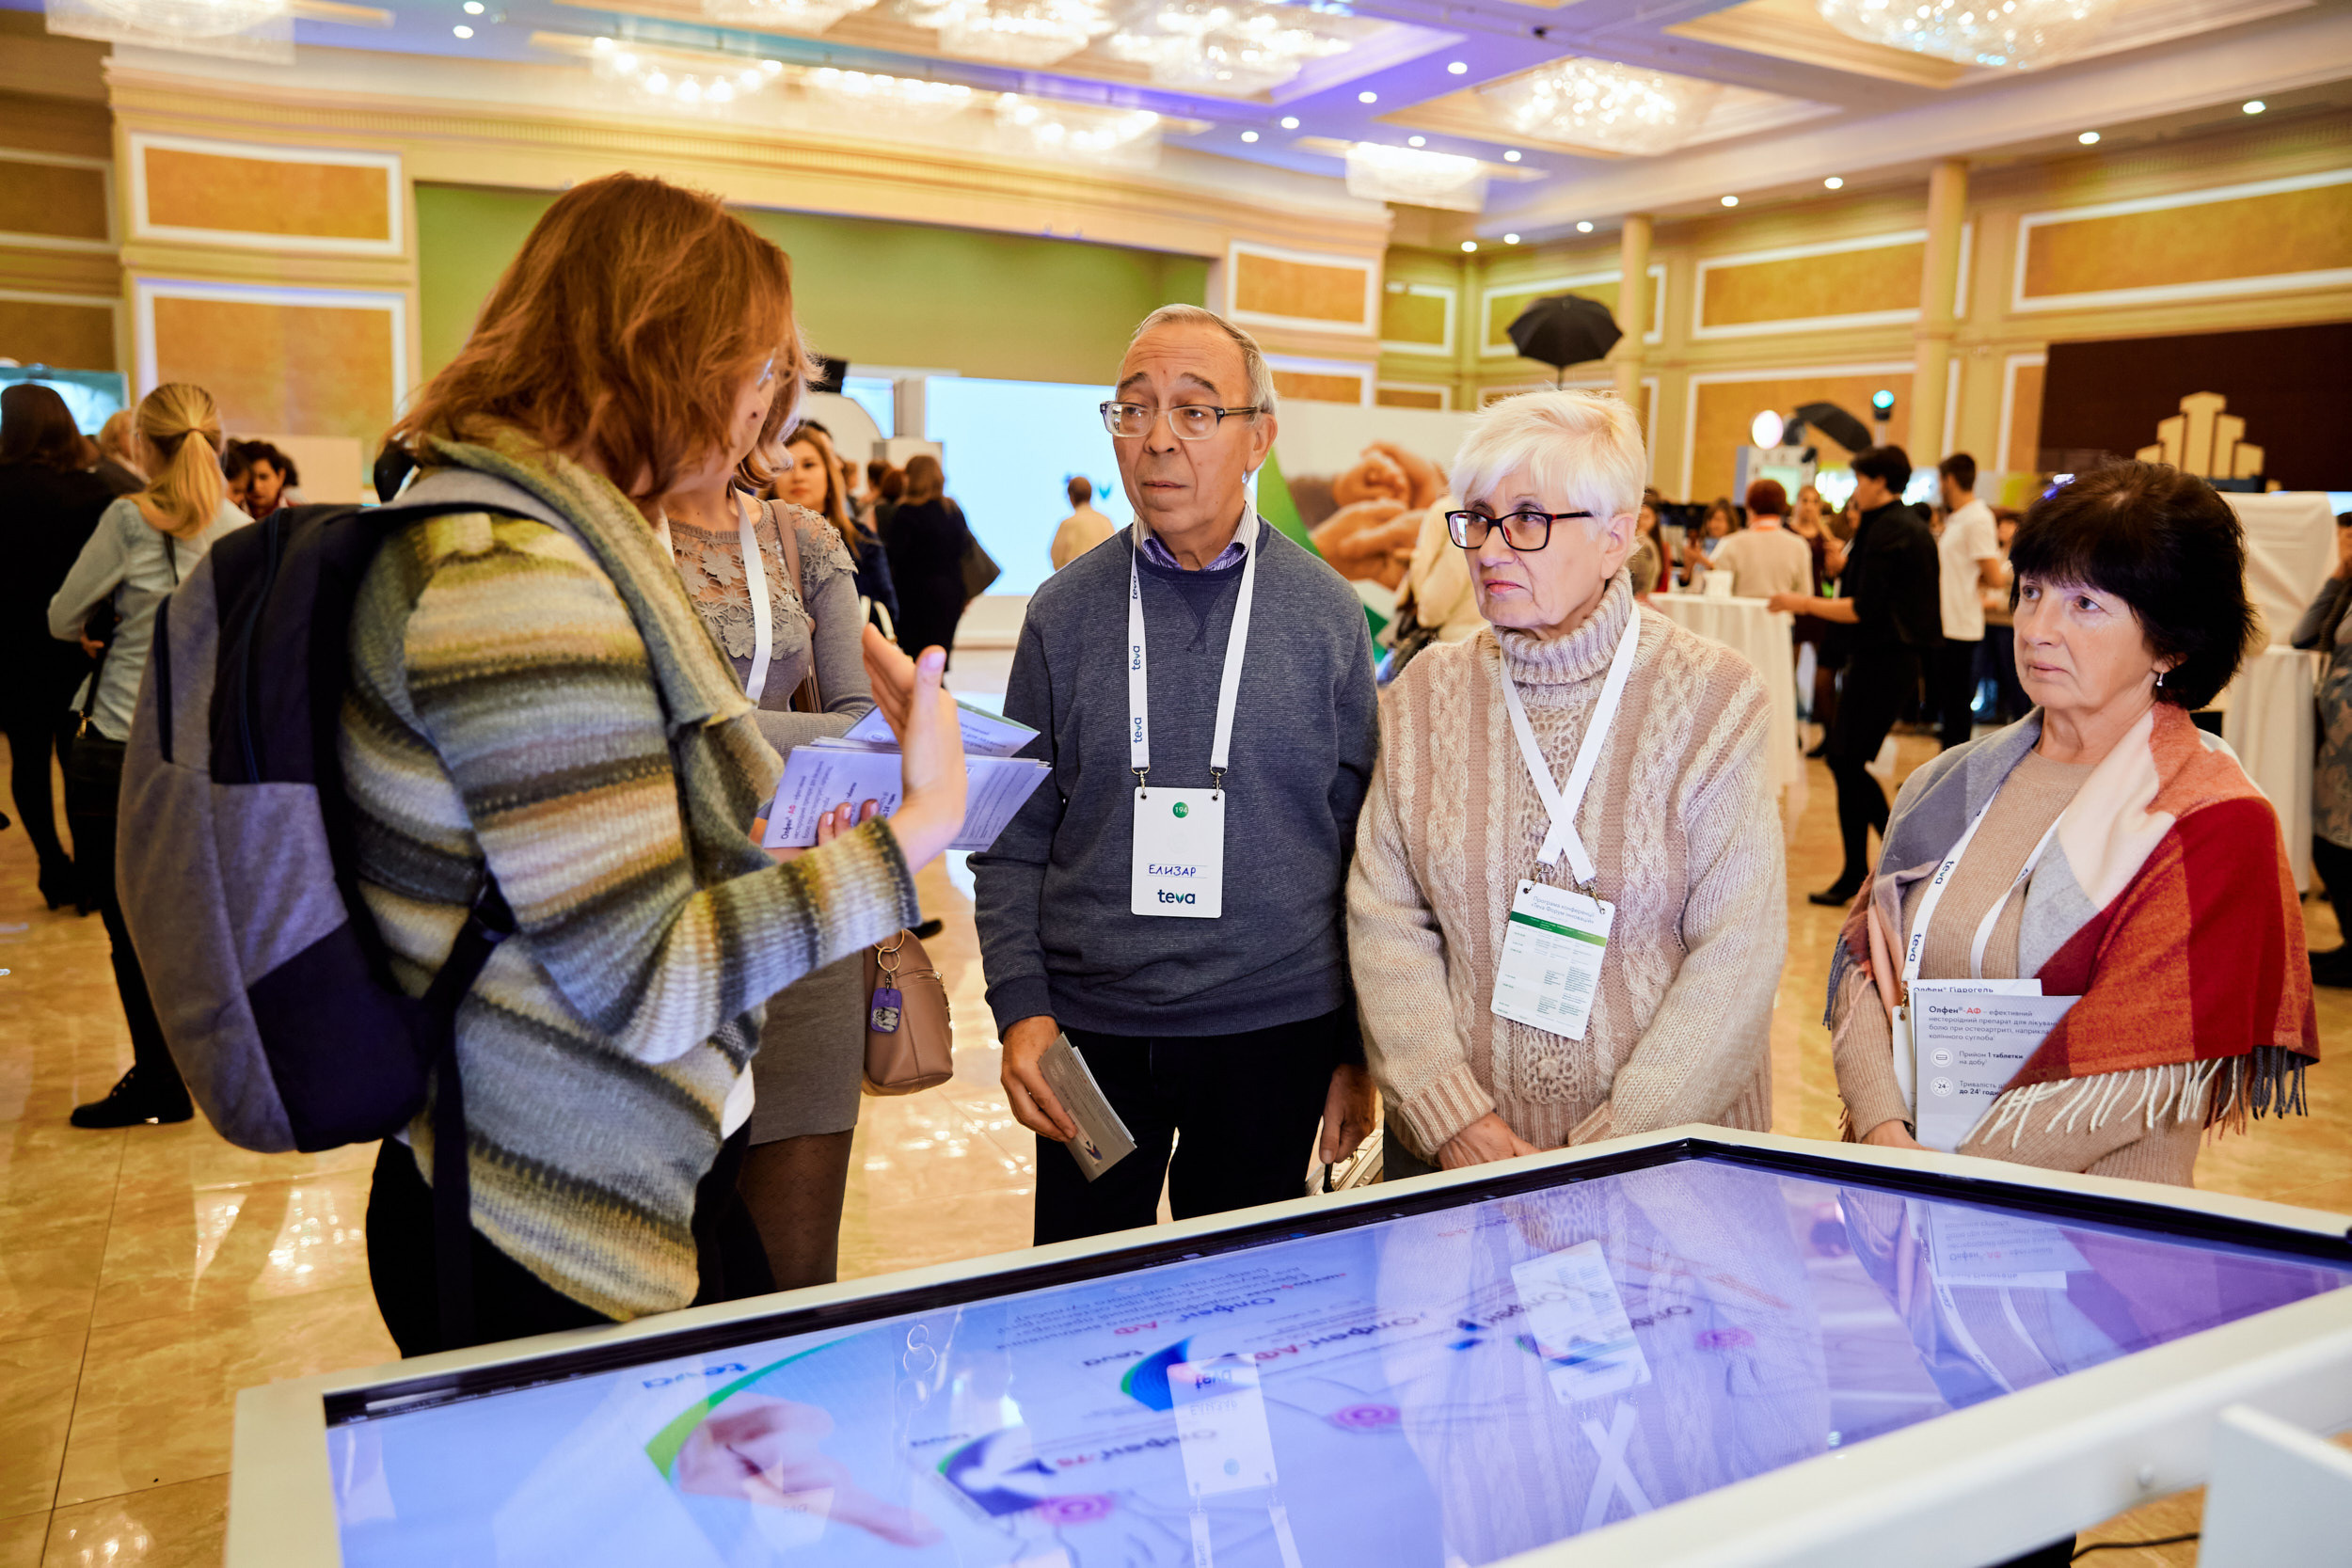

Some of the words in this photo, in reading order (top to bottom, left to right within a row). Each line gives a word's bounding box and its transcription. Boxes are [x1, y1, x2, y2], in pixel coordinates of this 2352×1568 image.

[1132, 645, 1140, 671] teva
[1133, 717, 1142, 743] teva
[1148, 863, 1197, 878] ЕЛИЗАР
[1934, 860, 1955, 885] teva
[1157, 889, 1196, 904] teva
[1909, 933, 1922, 962] teva
[643, 1363, 750, 1389] teva
